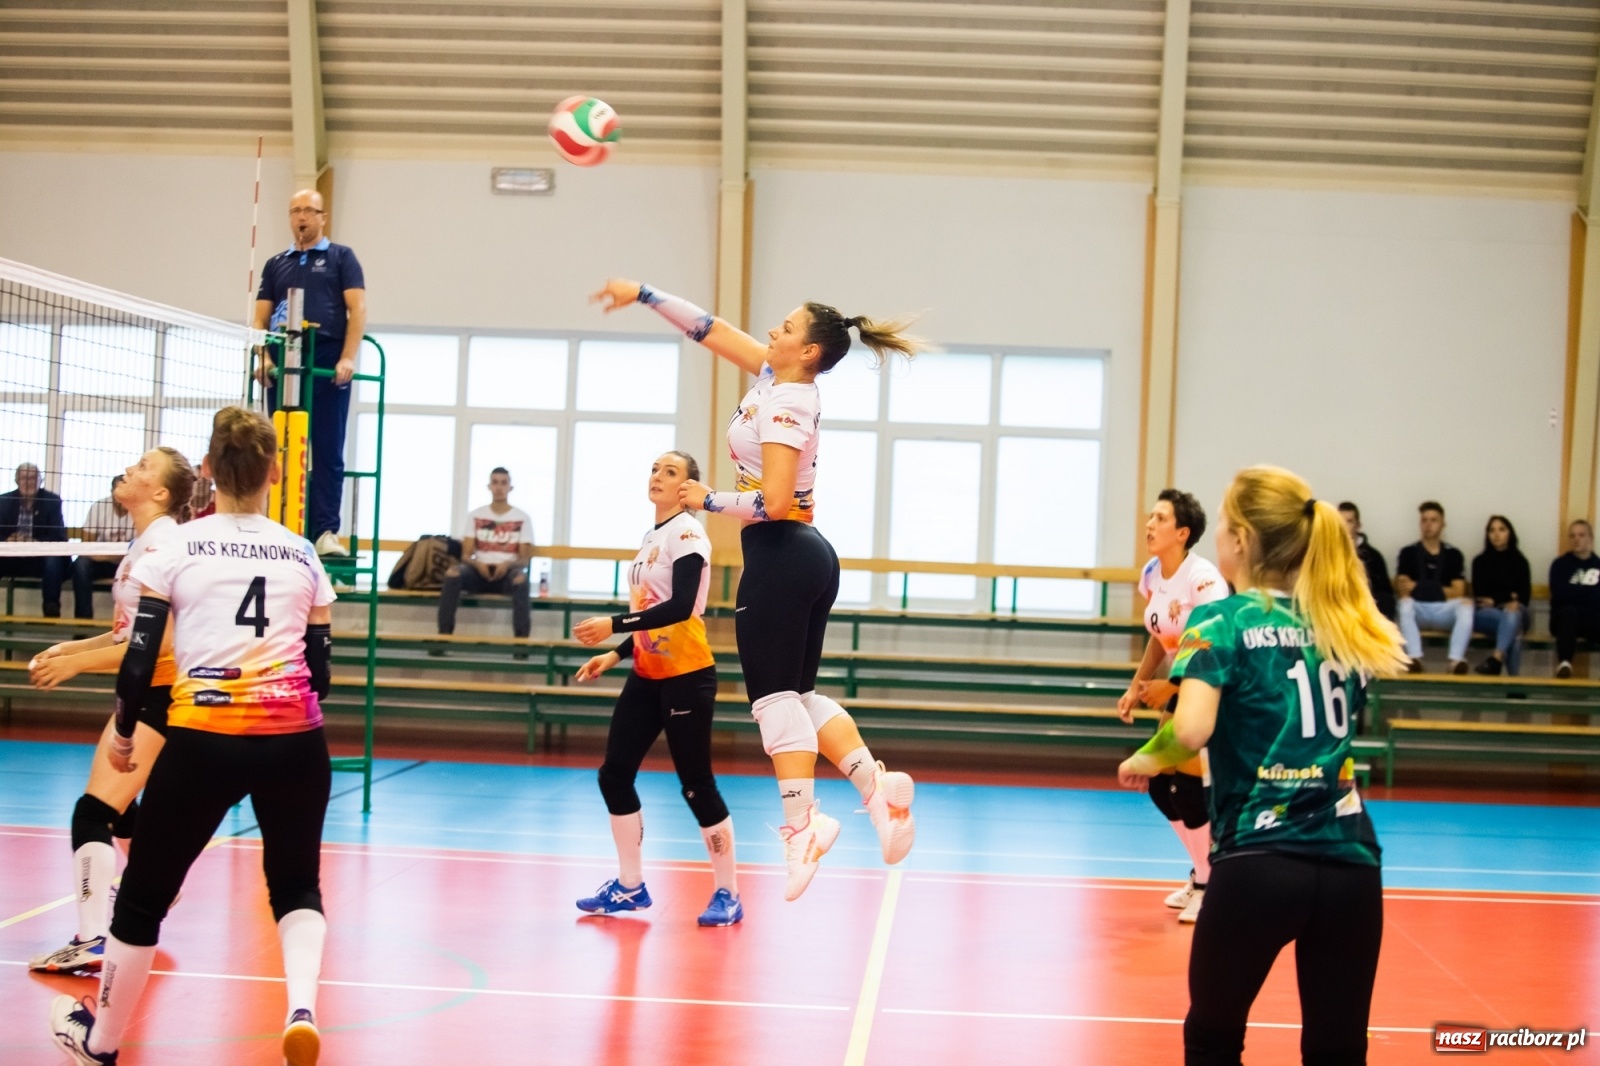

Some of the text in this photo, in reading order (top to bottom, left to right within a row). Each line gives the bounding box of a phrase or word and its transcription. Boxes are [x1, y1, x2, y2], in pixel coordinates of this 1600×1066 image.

[187, 540, 217, 556] UKS
[235, 575, 270, 638] 4
[1150, 612, 1161, 634] 8
[1242, 626, 1279, 650] UKS
[1286, 659, 1348, 739] 16
